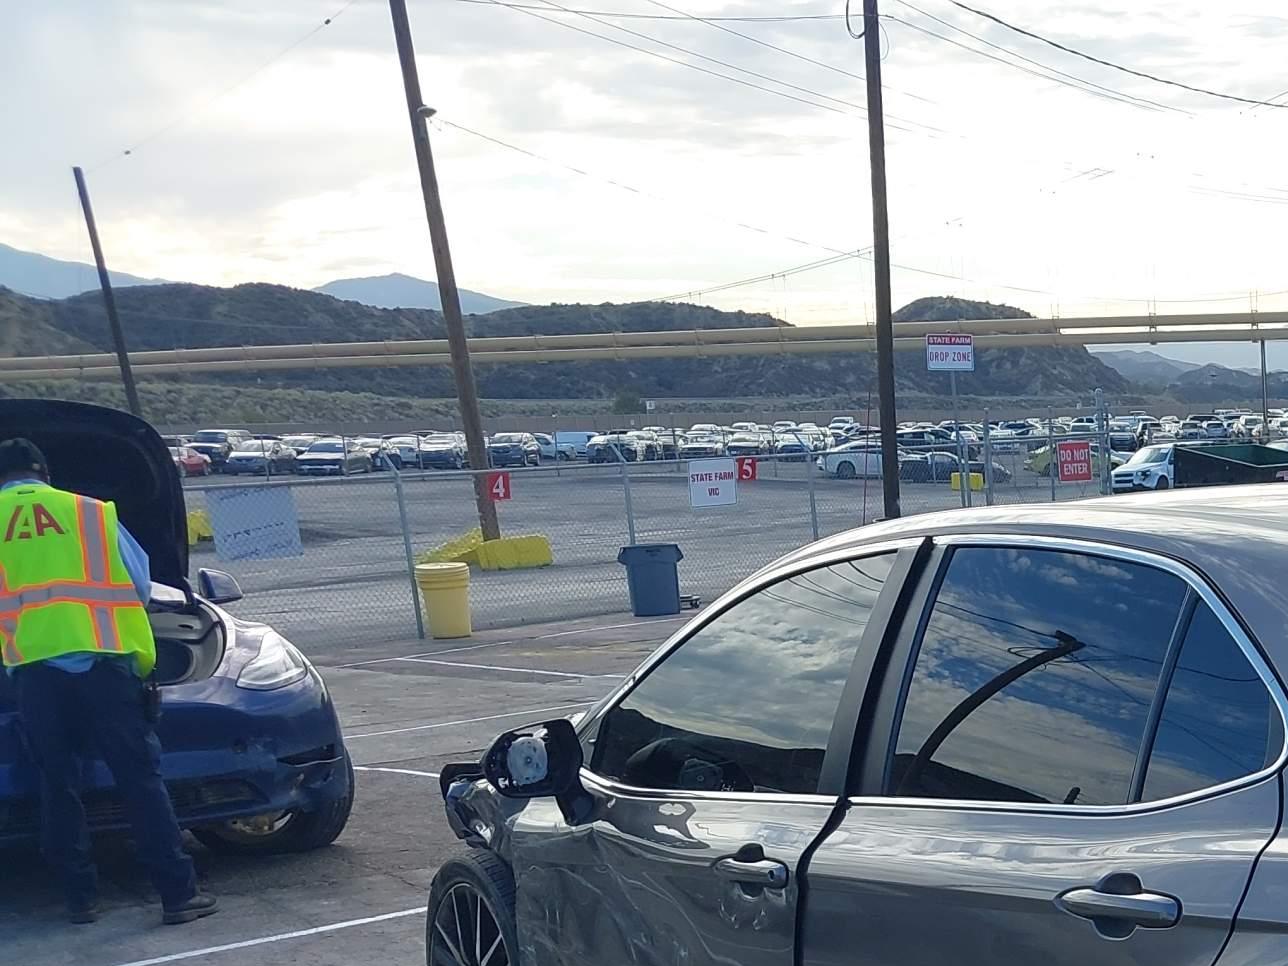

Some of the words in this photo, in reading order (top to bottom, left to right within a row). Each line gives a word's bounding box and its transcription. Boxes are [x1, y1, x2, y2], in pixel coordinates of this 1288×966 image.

[928, 336, 950, 344] STATE
[951, 336, 971, 344] FARM
[929, 351, 950, 362] DROP
[952, 351, 972, 362] ZONE
[1060, 449, 1072, 461] DO
[1073, 448, 1089, 461] NOT
[742, 458, 753, 479] 5
[1063, 462, 1089, 476] ENTER
[690, 472, 714, 483] STATE
[714, 471, 734, 481] FARM
[492, 474, 506, 498] 4
